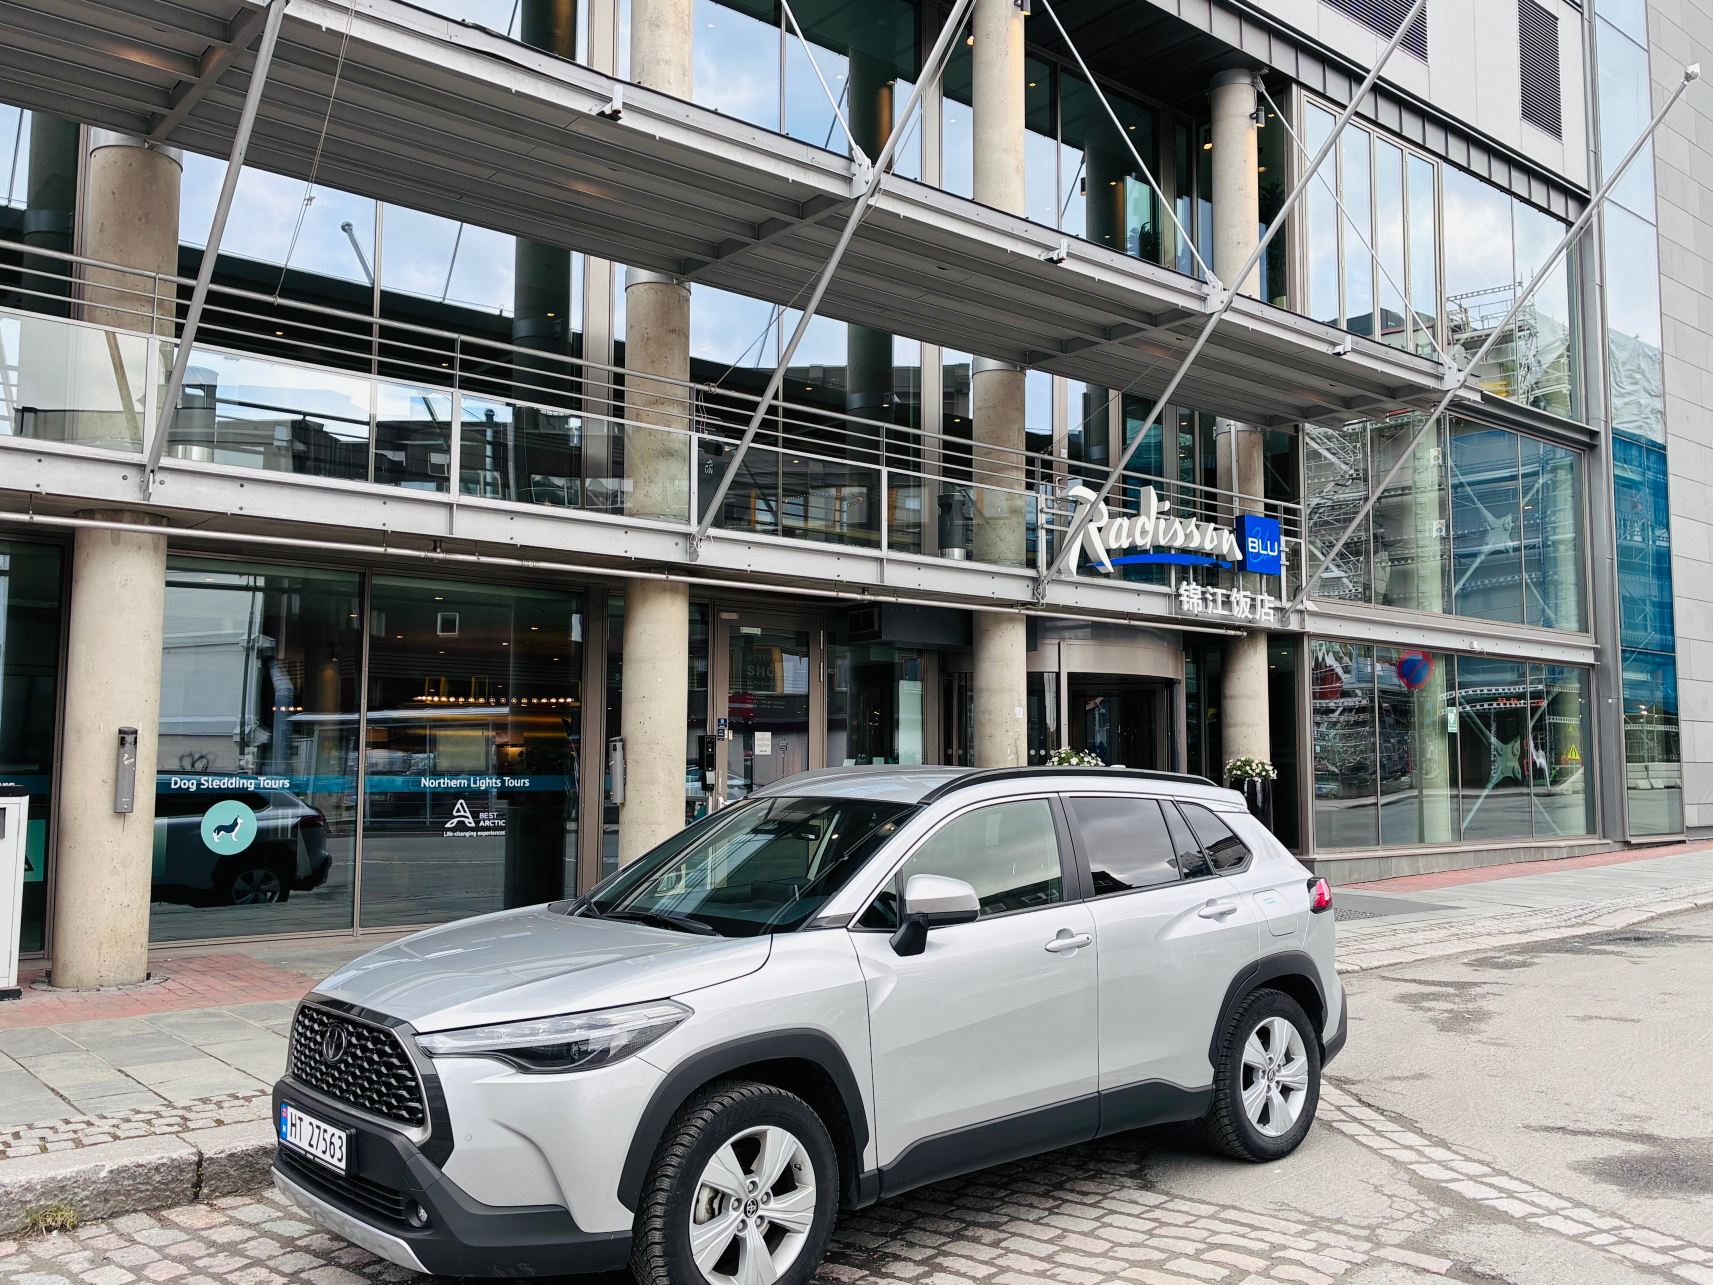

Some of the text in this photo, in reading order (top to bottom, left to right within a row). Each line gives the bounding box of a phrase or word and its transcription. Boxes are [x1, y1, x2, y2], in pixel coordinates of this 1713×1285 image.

[1060, 485, 1243, 578] Radisson
[1248, 537, 1279, 556] BLU
[1178, 581, 1274, 622] 锦江饭店
[170, 777, 290, 791] Dog Sledding Tours
[420, 777, 529, 790] Northern Lights Tours
[290, 1112, 343, 1162] HT 27563
